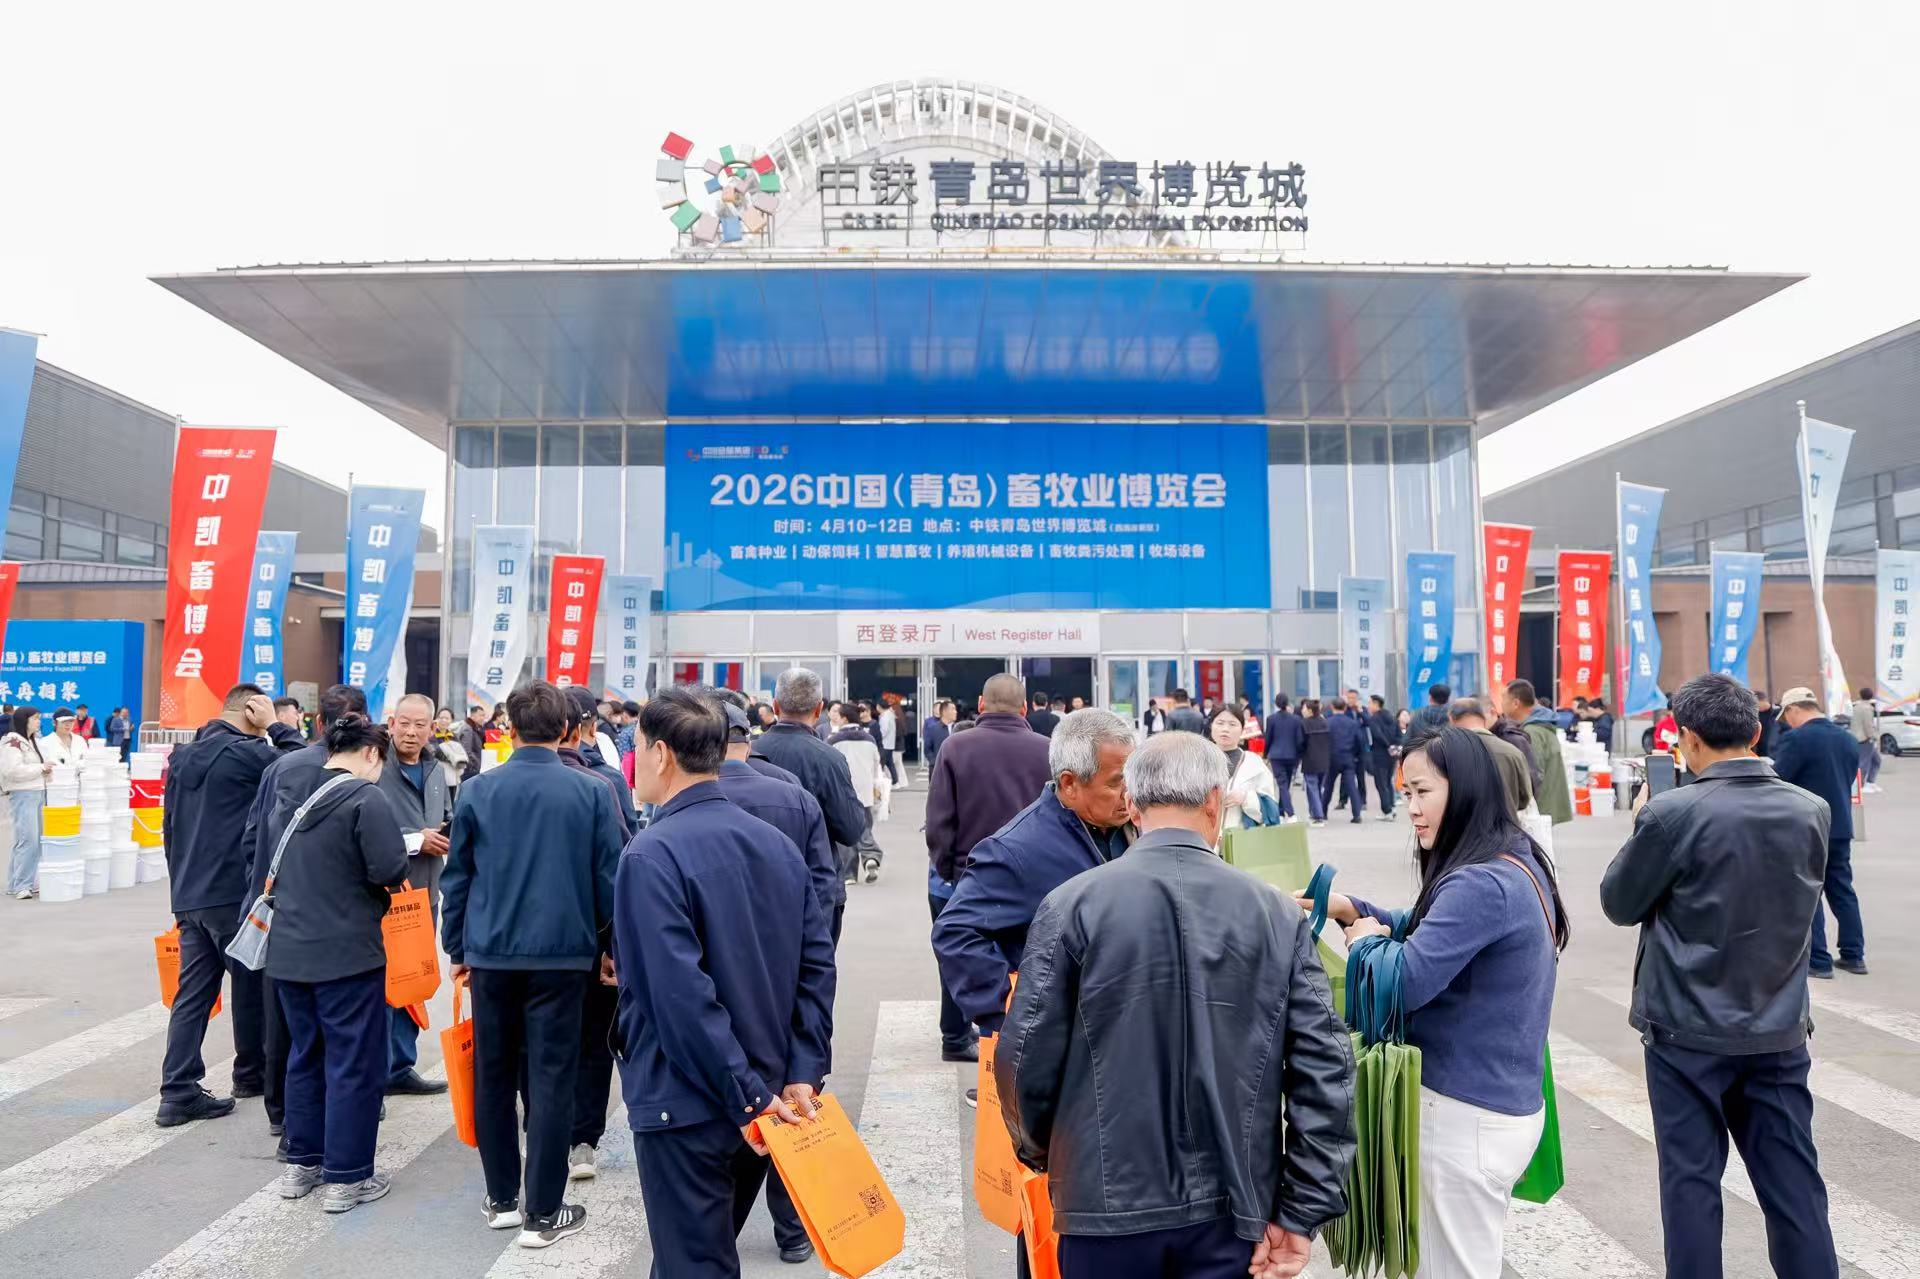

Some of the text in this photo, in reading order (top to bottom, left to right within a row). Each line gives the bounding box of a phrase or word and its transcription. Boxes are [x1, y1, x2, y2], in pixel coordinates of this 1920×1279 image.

[817, 156, 1307, 208] 中铁青岛世界博览城
[931, 212, 1025, 232] QINGDAO
[1031, 212, 1186, 231] COSMOPOLITAN
[1192, 214, 1308, 232] EXPOSITION
[710, 473, 1227, 508] 2026中国（青岛）畜牧业博览会
[1149, 543, 1206, 558] 牧场设备
[174, 473, 230, 679] 中凯畜博会
[349, 523, 393, 688] 中凯畜博会
[856, 624, 1082, 644] 西登录厅 West Register Hall
[2, 651, 107, 665] 岛）畜牧业博览会
